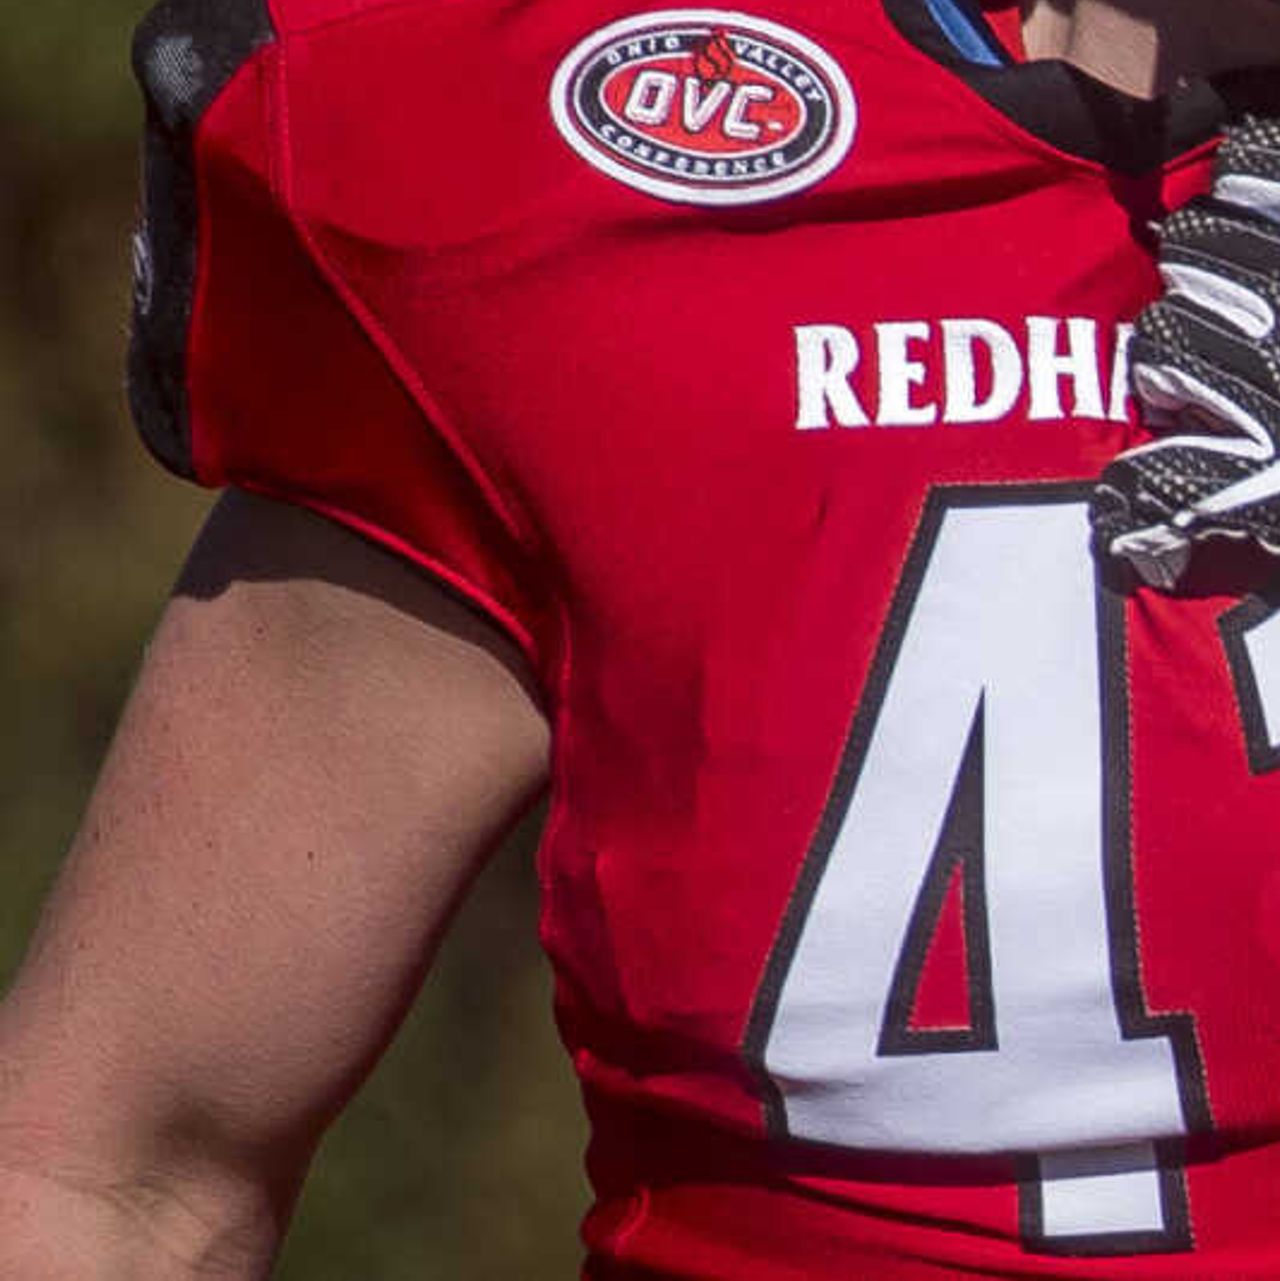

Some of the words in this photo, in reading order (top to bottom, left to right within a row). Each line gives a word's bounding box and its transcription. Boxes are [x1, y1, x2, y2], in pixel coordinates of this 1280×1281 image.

[606, 35, 681, 63] OHIO
[735, 40, 823, 101] VALLEY
[624, 70, 774, 141] OVC
